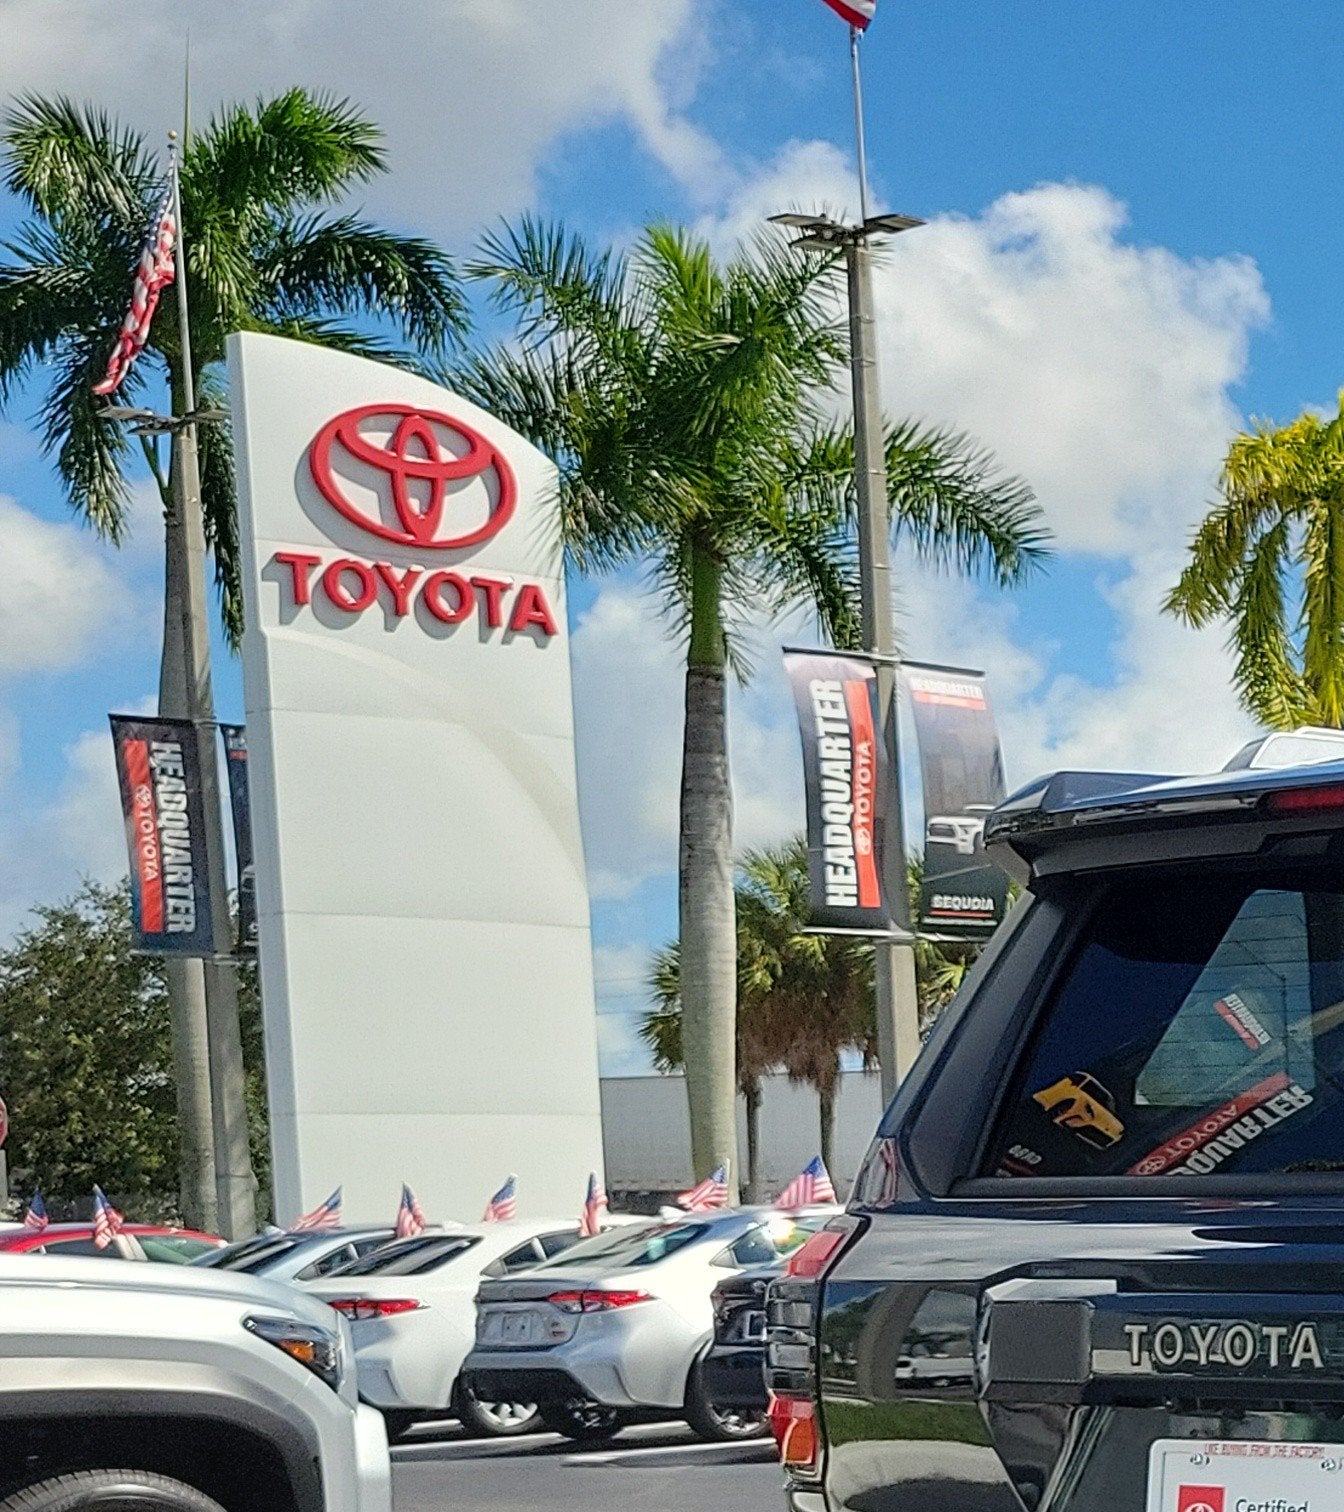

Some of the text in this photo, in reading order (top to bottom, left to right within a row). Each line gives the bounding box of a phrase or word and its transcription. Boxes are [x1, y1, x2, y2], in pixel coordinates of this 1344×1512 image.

[275, 551, 558, 637] TOYOTA
[809, 678, 859, 908] HEADQUARTER
[855, 741, 873, 824] TOYOTA
[137, 809, 159, 882] TOYOTA
[151, 741, 196, 933] HEADQUARTER
[1124, 1322, 1324, 1369] TOYOTA
[1250, 1444, 1271, 1457] FROM
[1273, 1445, 1288, 1458] THE
